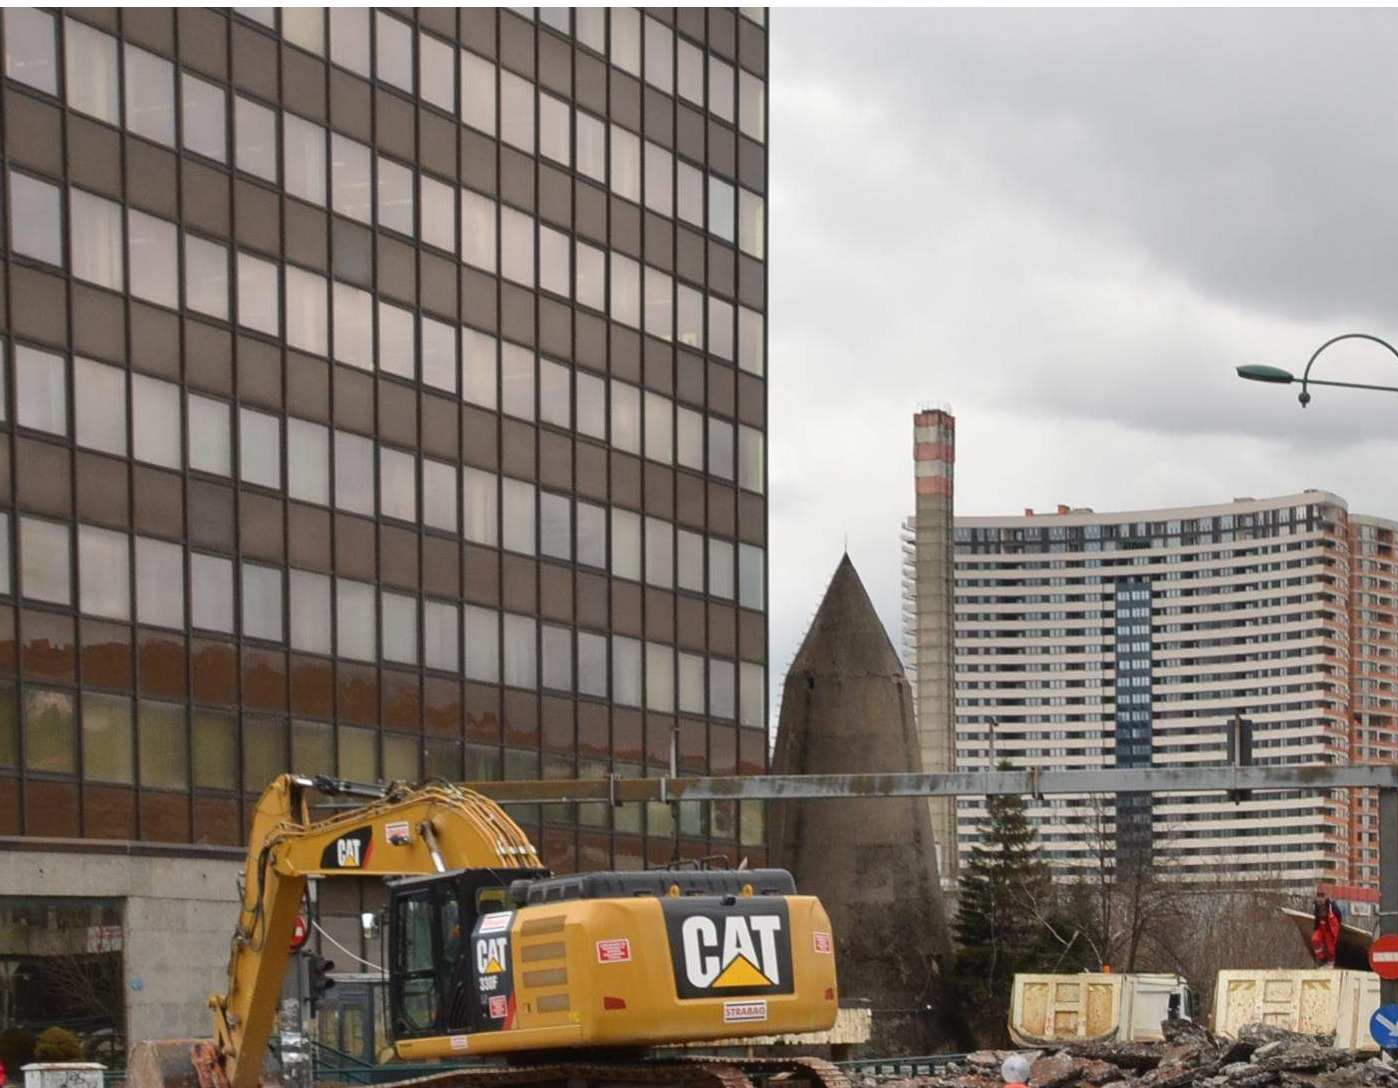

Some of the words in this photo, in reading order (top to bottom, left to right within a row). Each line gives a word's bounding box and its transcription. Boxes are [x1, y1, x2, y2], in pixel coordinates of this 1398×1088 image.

[337, 838, 361, 867] CAT
[476, 936, 507, 974] CAT
[682, 915, 781, 989] CAT
